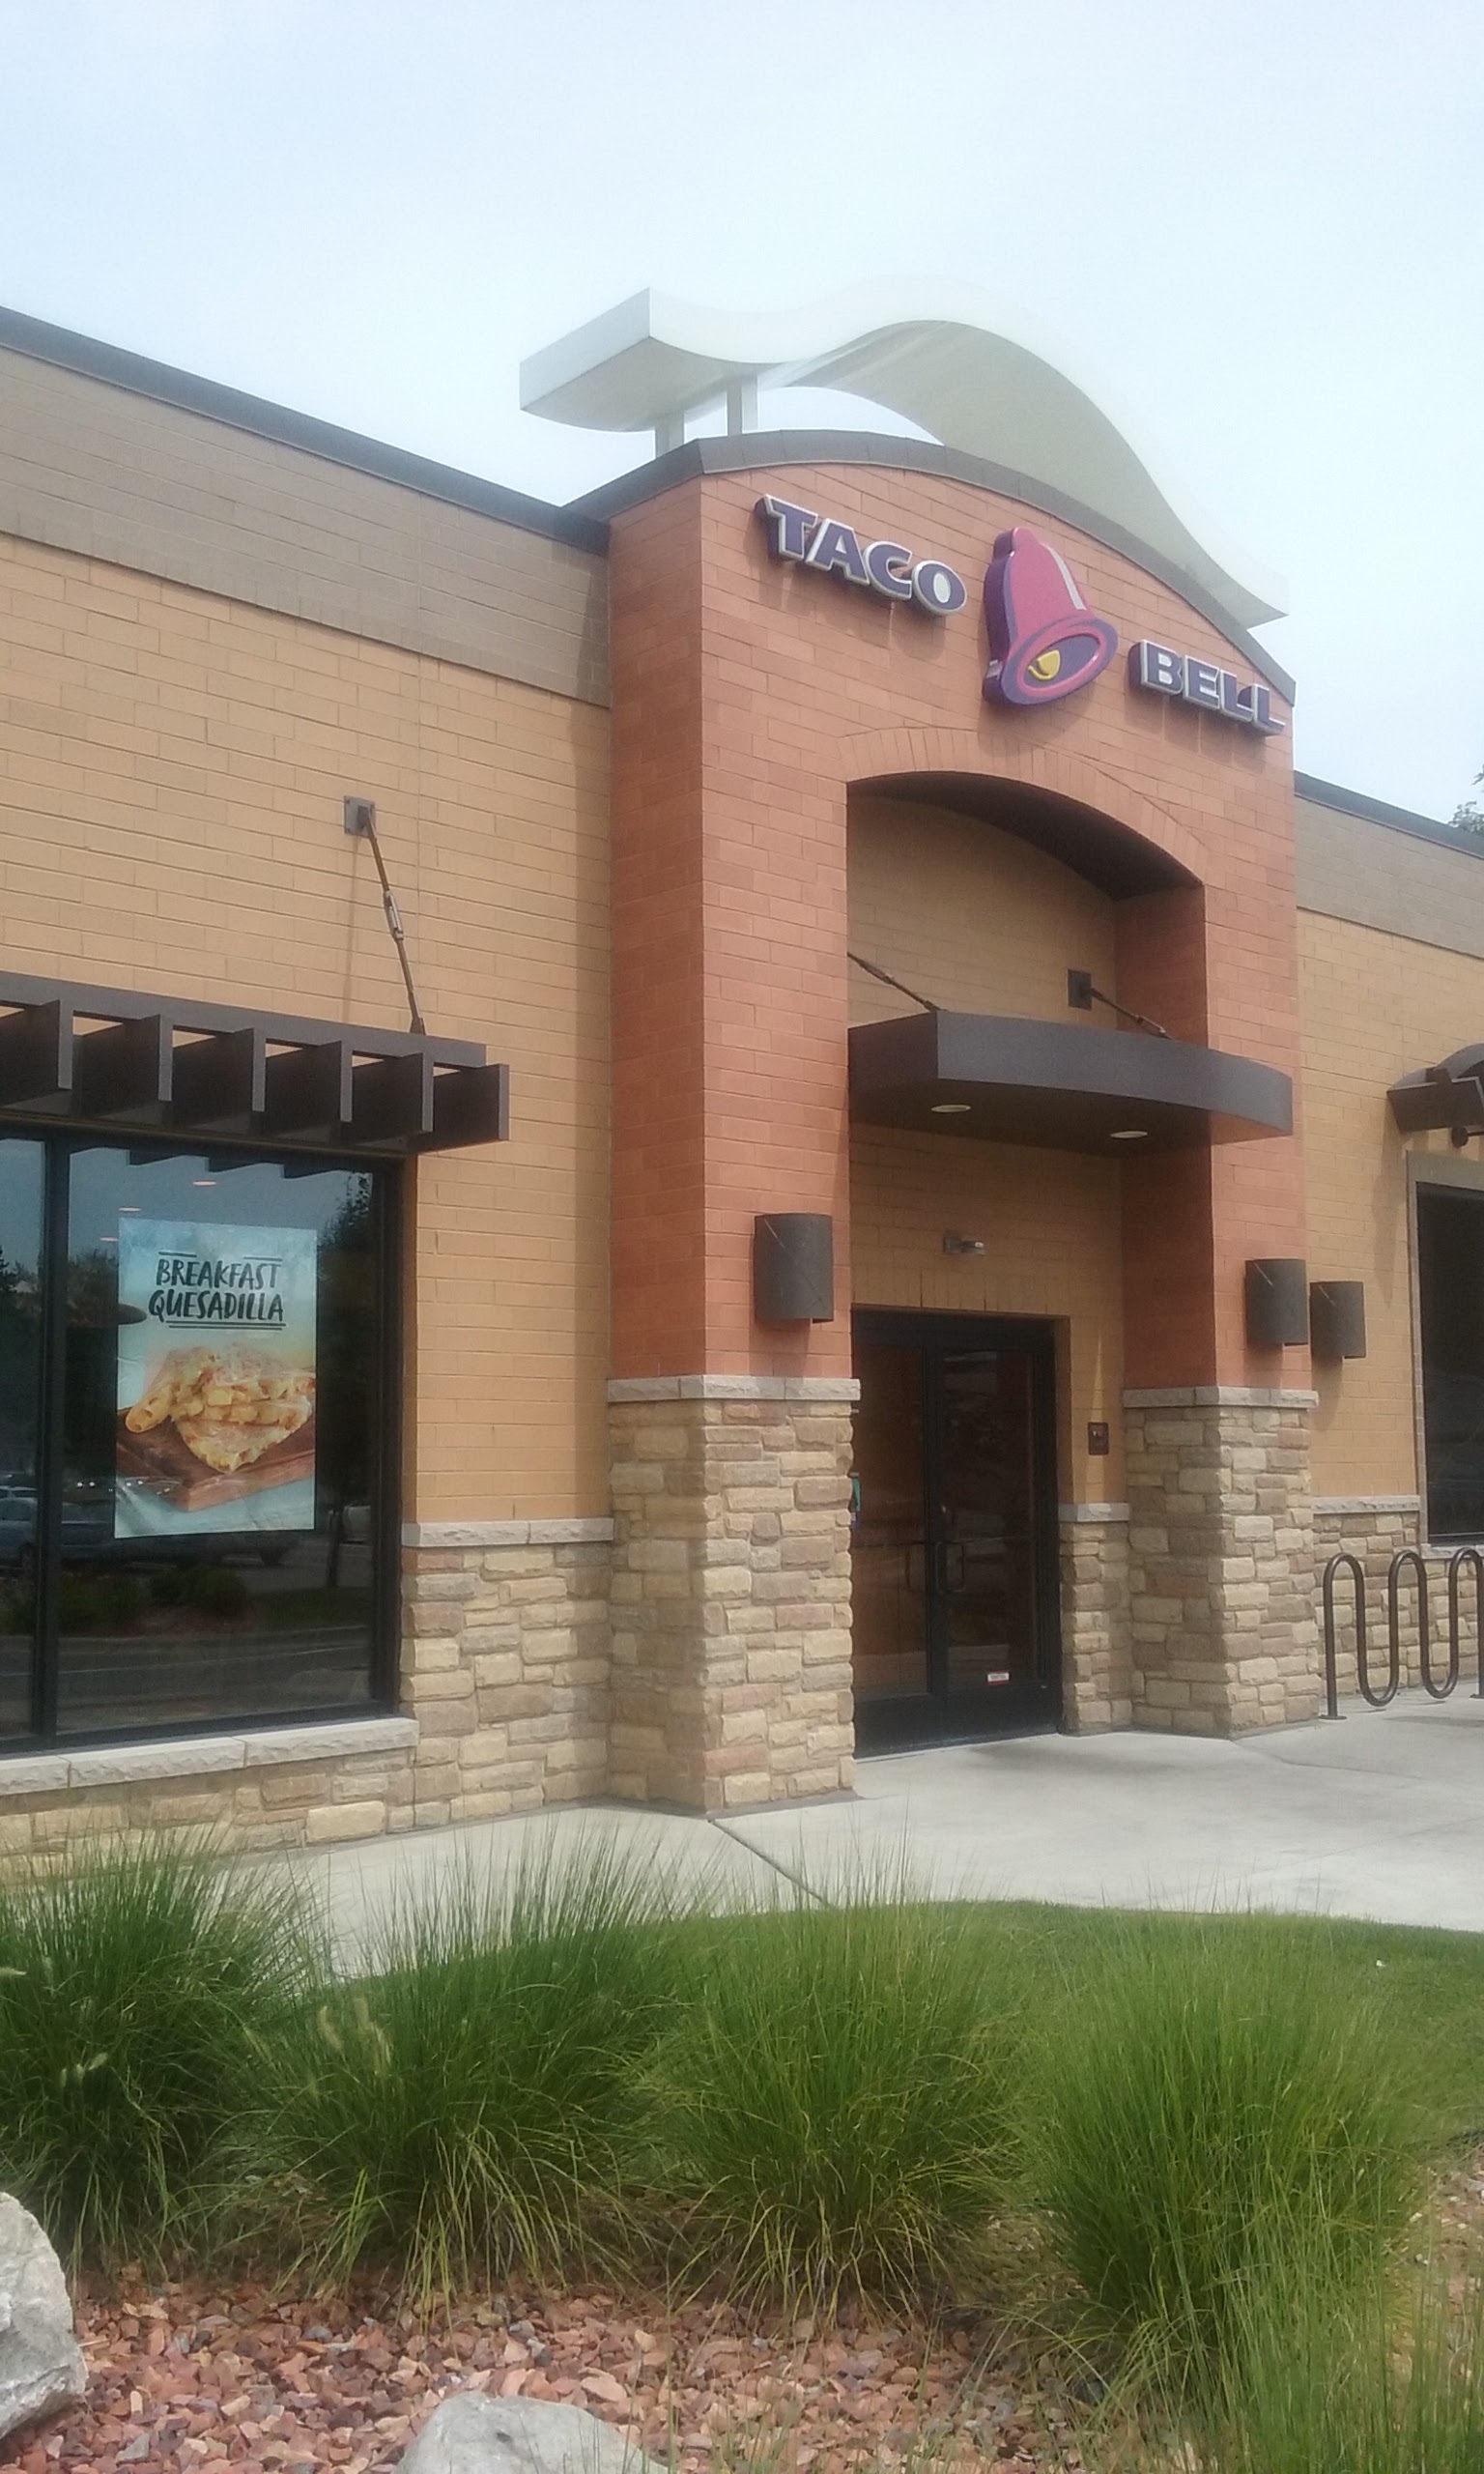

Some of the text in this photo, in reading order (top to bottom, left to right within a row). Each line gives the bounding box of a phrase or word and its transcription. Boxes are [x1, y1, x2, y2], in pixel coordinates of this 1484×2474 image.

[755, 494, 1286, 736] TACO BELL
[156, 1258, 282, 1290] BREAKFAST
[148, 1288, 284, 1323] QUESADILLA
